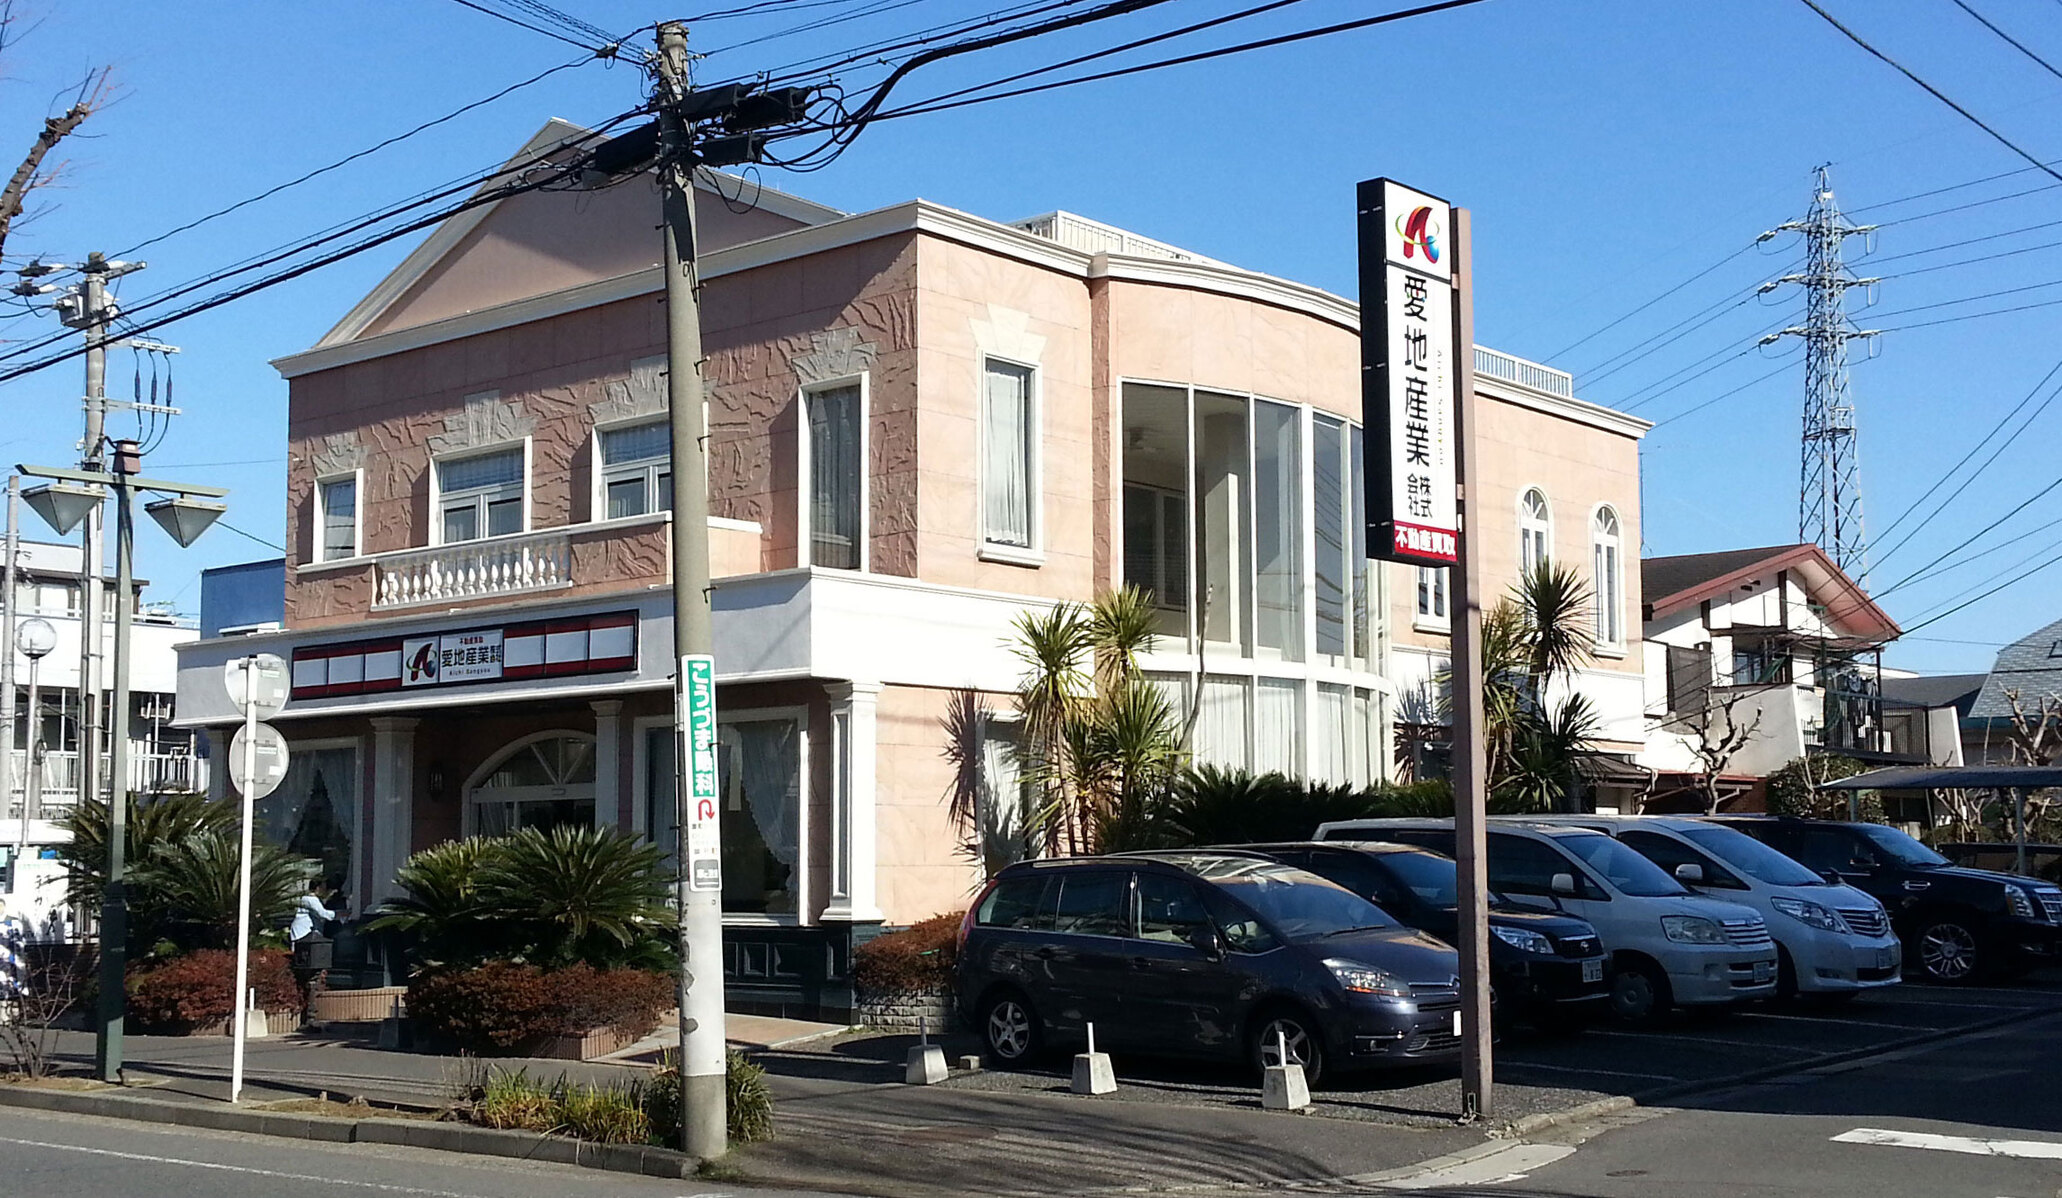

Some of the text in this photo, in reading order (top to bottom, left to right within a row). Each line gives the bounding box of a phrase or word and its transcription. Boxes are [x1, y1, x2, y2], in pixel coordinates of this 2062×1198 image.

[1403, 275, 1430, 468] 愛地産業
[441, 645, 490, 668] 愛地産業
